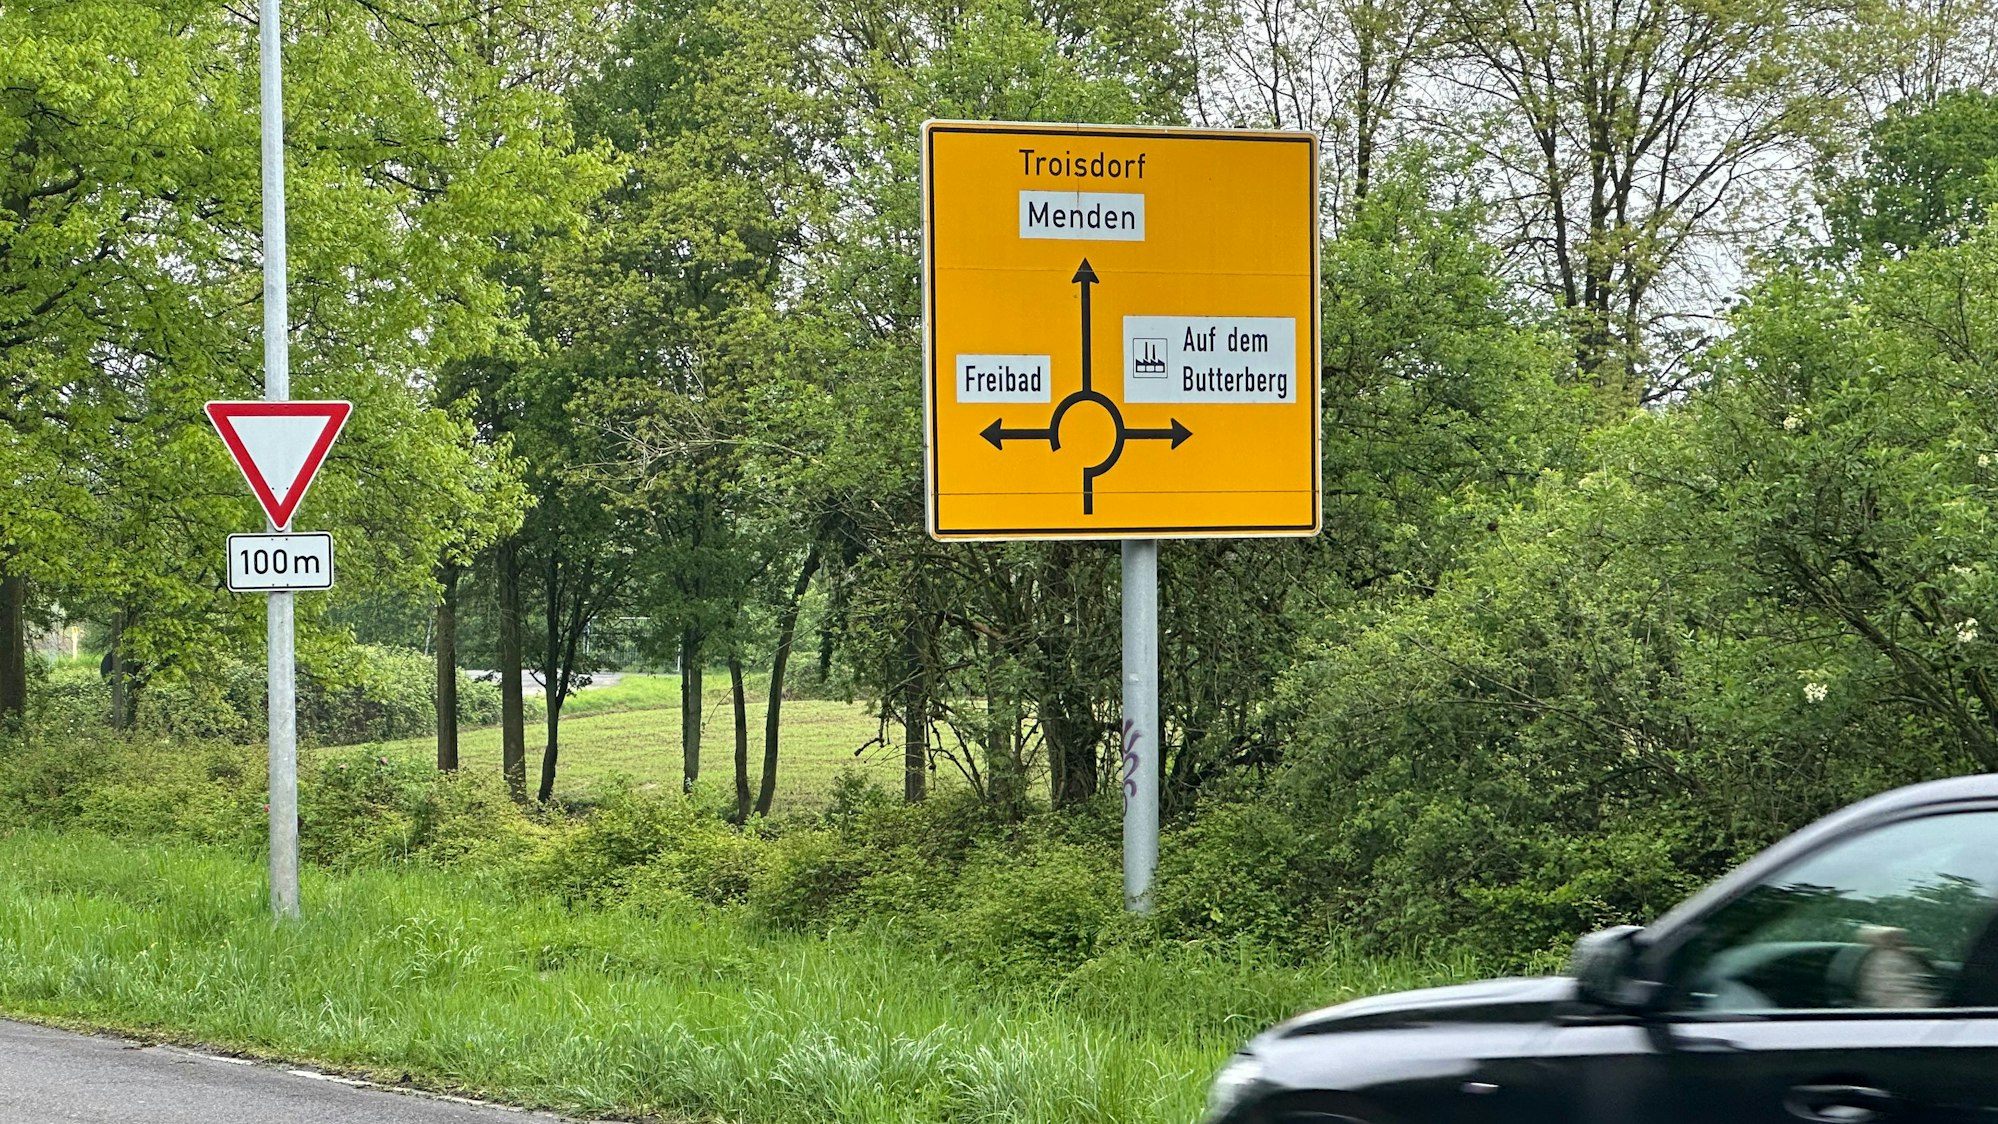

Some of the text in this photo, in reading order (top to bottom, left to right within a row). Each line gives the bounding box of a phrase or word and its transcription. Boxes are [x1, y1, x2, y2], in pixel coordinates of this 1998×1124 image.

[1018, 149, 1146, 179] Troisdorf
[1028, 201, 1135, 230] Menden
[1182, 325, 1268, 353] Auf dem
[965, 365, 1041, 392] Freibad
[1182, 365, 1287, 400] Butterberg
